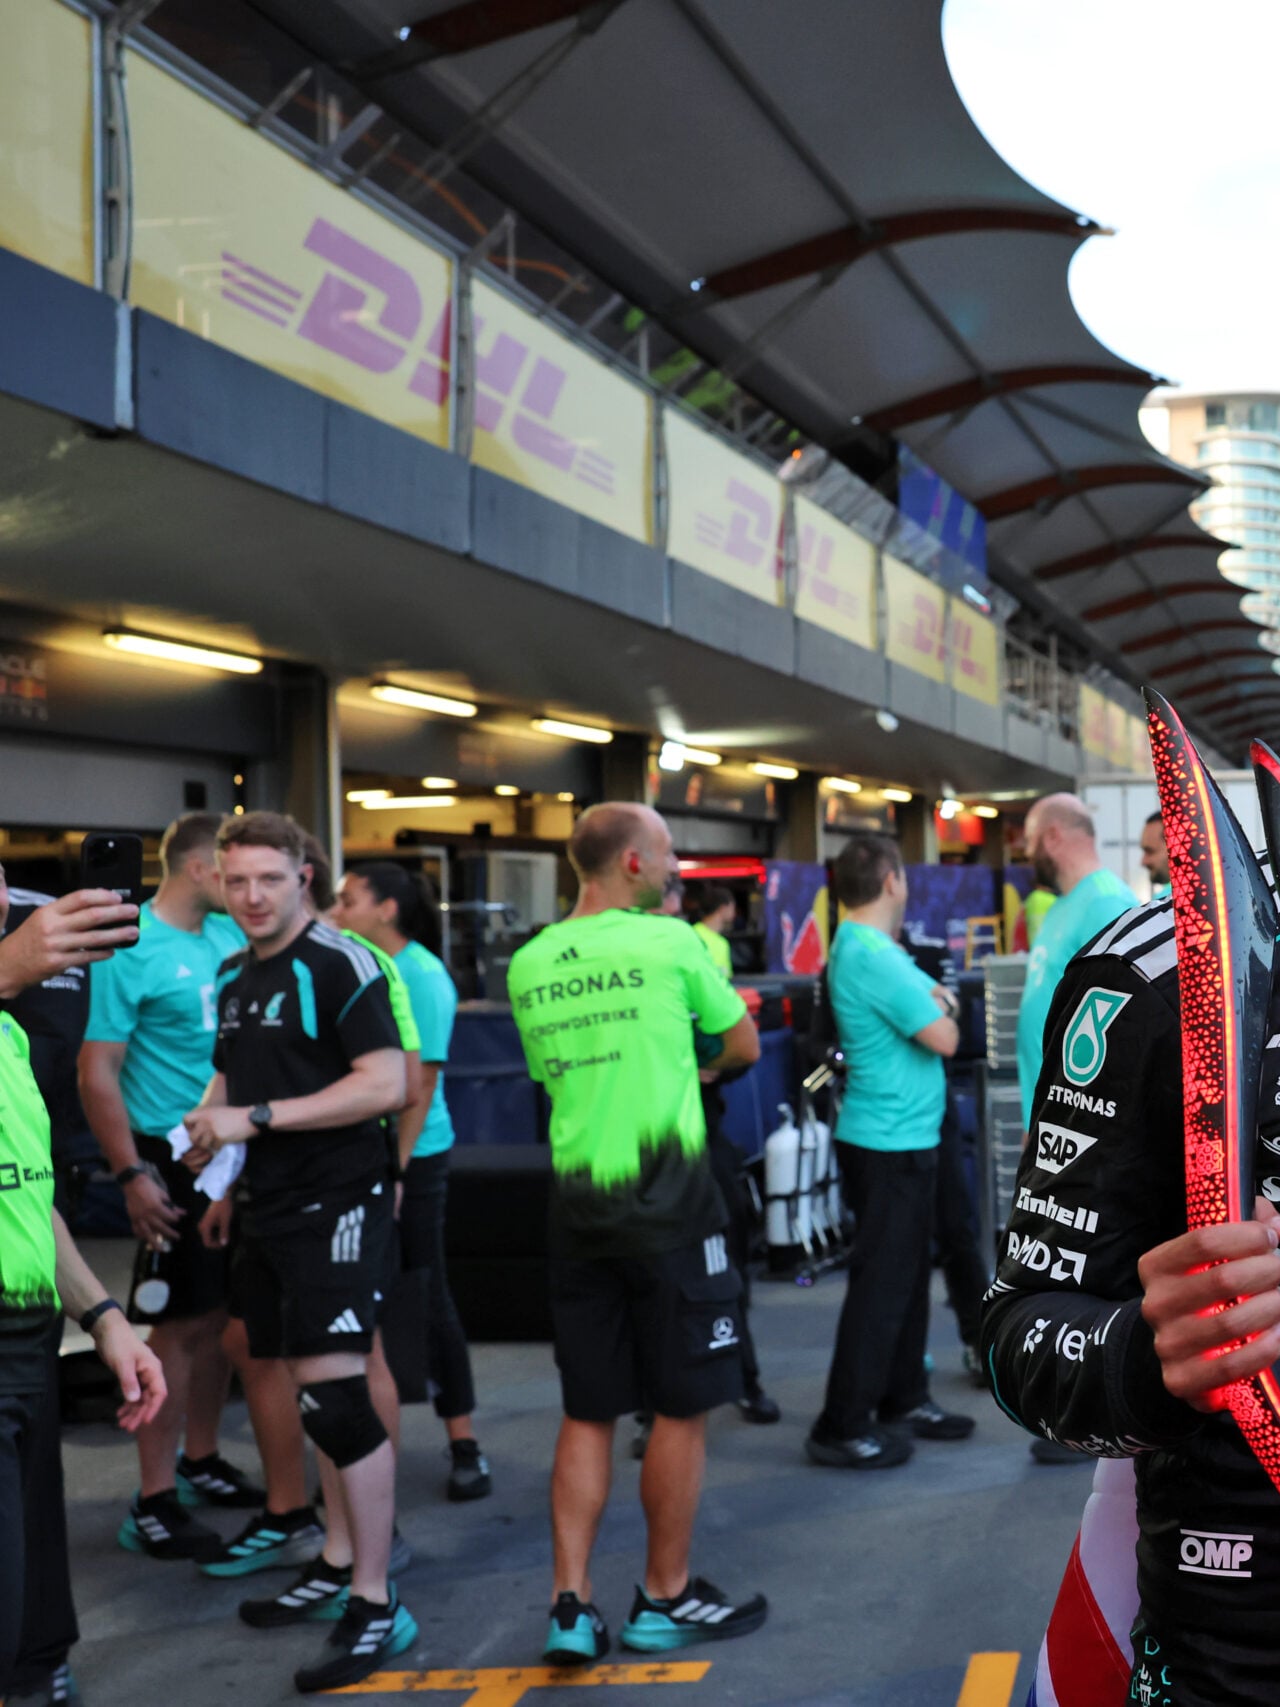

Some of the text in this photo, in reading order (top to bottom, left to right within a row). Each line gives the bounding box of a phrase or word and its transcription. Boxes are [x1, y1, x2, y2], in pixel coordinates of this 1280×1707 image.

[297, 216, 577, 472] DHL
[1047, 1085, 1117, 1118] ETRONAS
[1039, 1131, 1078, 1167] SAP
[1007, 1231, 1051, 1272] AMD
[1180, 1536, 1253, 1570] OMP
